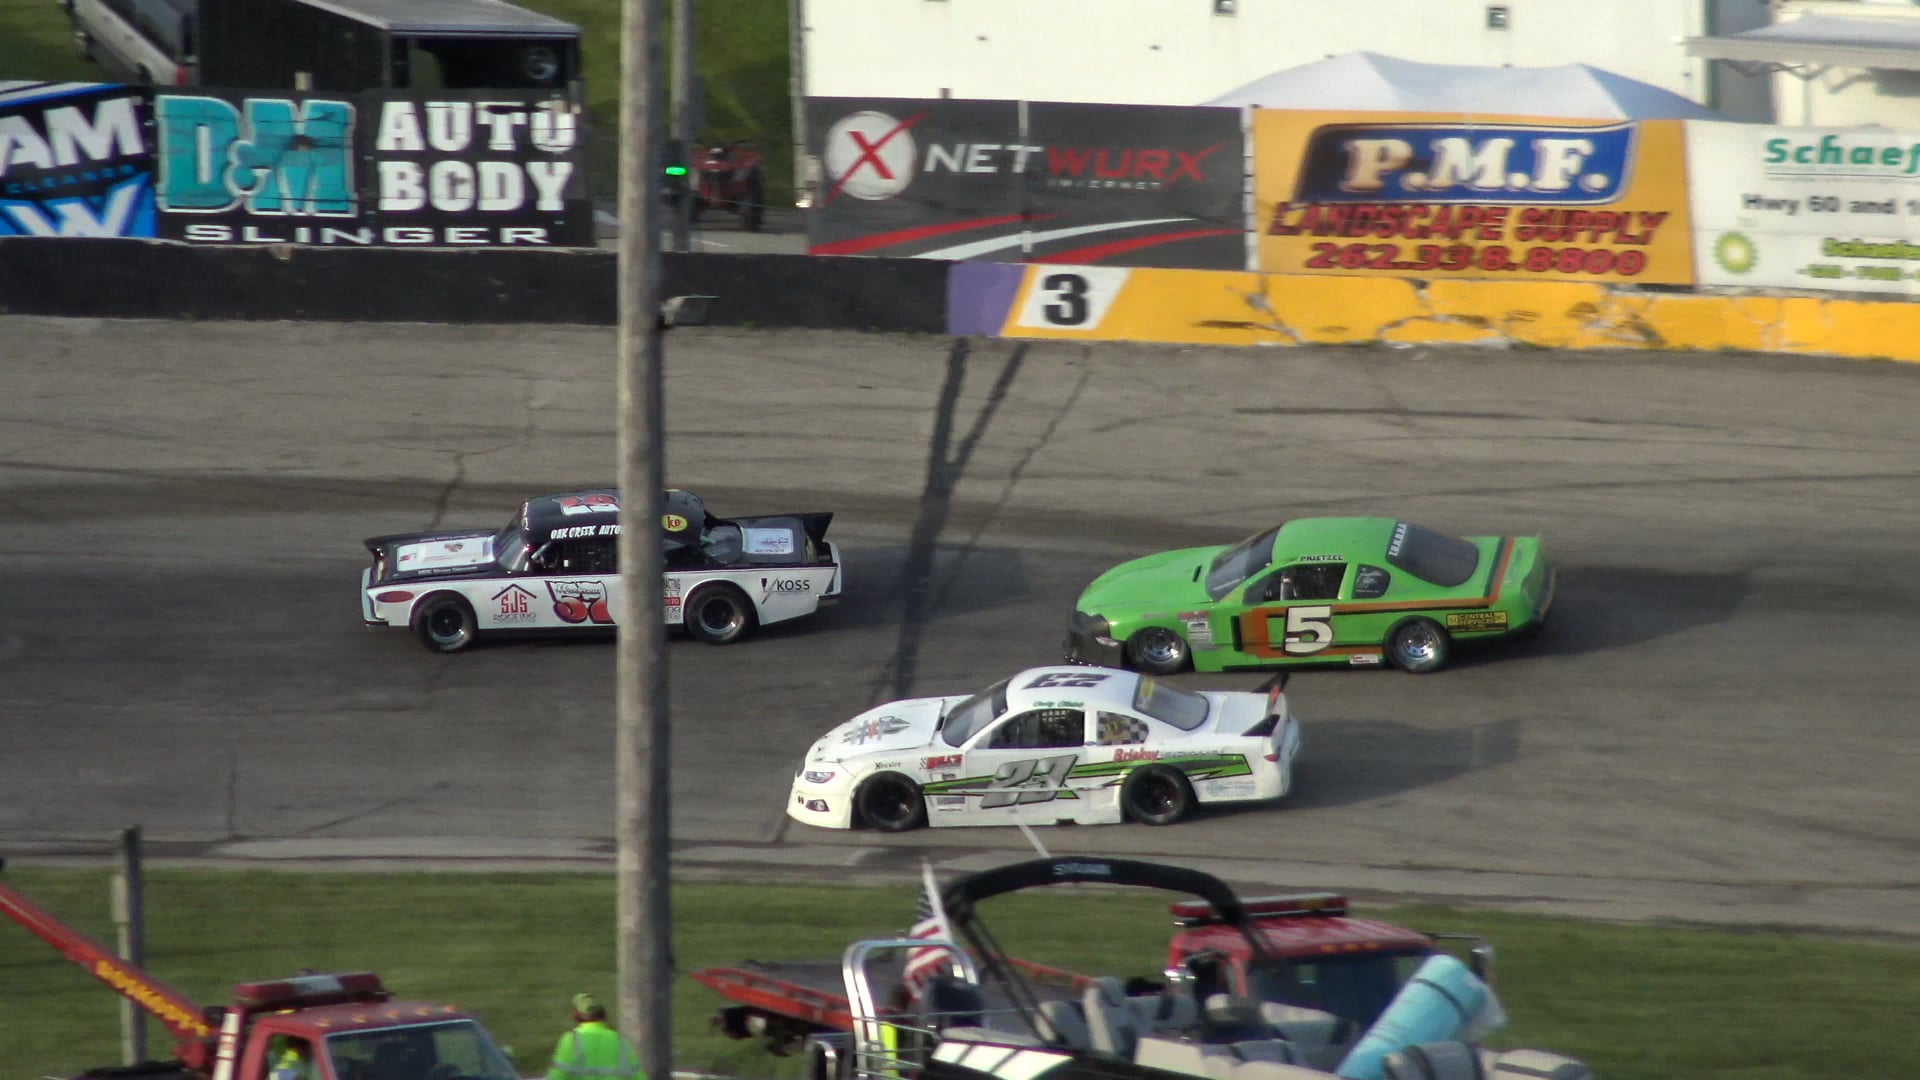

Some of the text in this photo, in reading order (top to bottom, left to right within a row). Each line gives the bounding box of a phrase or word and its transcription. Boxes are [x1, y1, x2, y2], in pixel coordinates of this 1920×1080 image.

[155, 95, 358, 217] D&M
[1339, 138, 1608, 192] P.M.F.
[1742, 193, 1797, 215] Hwy
[1848, 199, 1896, 214] and
[184, 225, 550, 244] SLINGER
[1268, 202, 1670, 245] LANDSCAPE SUPPLY
[1305, 242, 1647, 276] 262.338.8800
[1043, 273, 1089, 326] 3
[550, 528, 569, 540] OAK
[568, 525, 597, 538] CREEK
[501, 590, 528, 614] SJS
[777, 580, 810, 591] KOSS
[1283, 605, 1333, 657] 5
